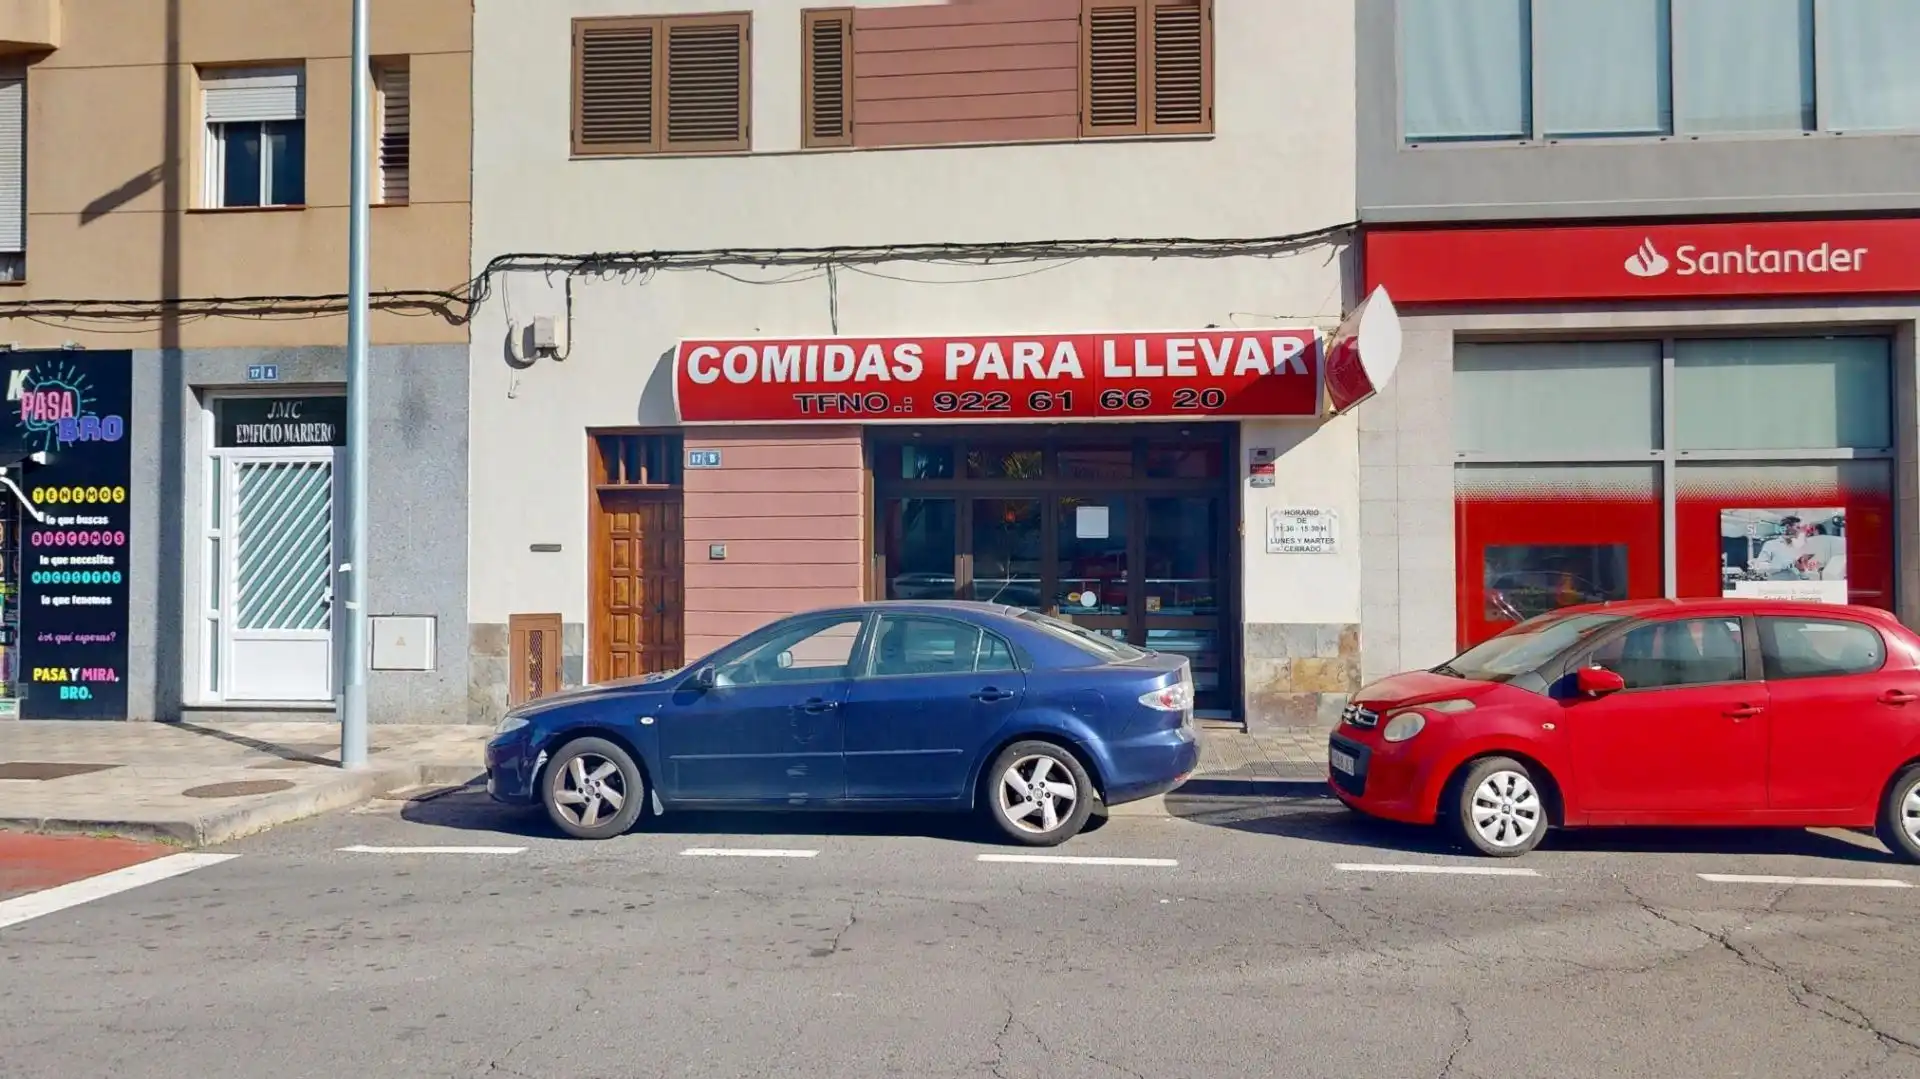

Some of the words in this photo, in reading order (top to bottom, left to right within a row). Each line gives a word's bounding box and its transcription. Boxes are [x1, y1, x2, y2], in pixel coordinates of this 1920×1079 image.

[1676, 242, 1868, 275] Santander
[686, 342, 924, 384] COMIDAS
[944, 341, 1084, 381] PARA
[1103, 336, 1309, 378] LLEVAR
[251, 368, 260, 378] 17
[267, 367, 274, 378] A
[6, 369, 31, 400] K
[20, 391, 74, 421] PASA
[932, 391, 1012, 412] 922
[1028, 391, 1073, 411] 61
[1100, 389, 1151, 410] 66
[1172, 388, 1226, 410] 20
[267, 401, 302, 419] JMC
[58, 415, 123, 442] BRO
[236, 423, 283, 443] EDIFICIO
[284, 423, 335, 443] MARRERO
[691, 454, 702, 464] 17
[32, 487, 125, 503] TENEMOS
[46, 514, 56, 525] lo
[57, 516, 74, 527] que
[76, 515, 109, 525] buscas
[1296, 517, 1308, 525] DE
[31, 531, 125, 546] BUSCAMOS
[1270, 537, 1296, 545] LUNES
[1303, 537, 1336, 545] MARTES
[1283, 545, 1322, 553] CERRADO
[39, 555, 50, 565] lo
[51, 556, 68, 568] que
[70, 554, 115, 565] necesitas
[31, 571, 122, 584] NECESITAS
[41, 595, 51, 605] lo
[52, 597, 70, 607] que
[71, 595, 113, 605] tenemos
[32, 667, 67, 682] PASA
[70, 667, 80, 681] Y
[81, 667, 120, 682] MIRA,
[60, 685, 93, 700] BRO.
